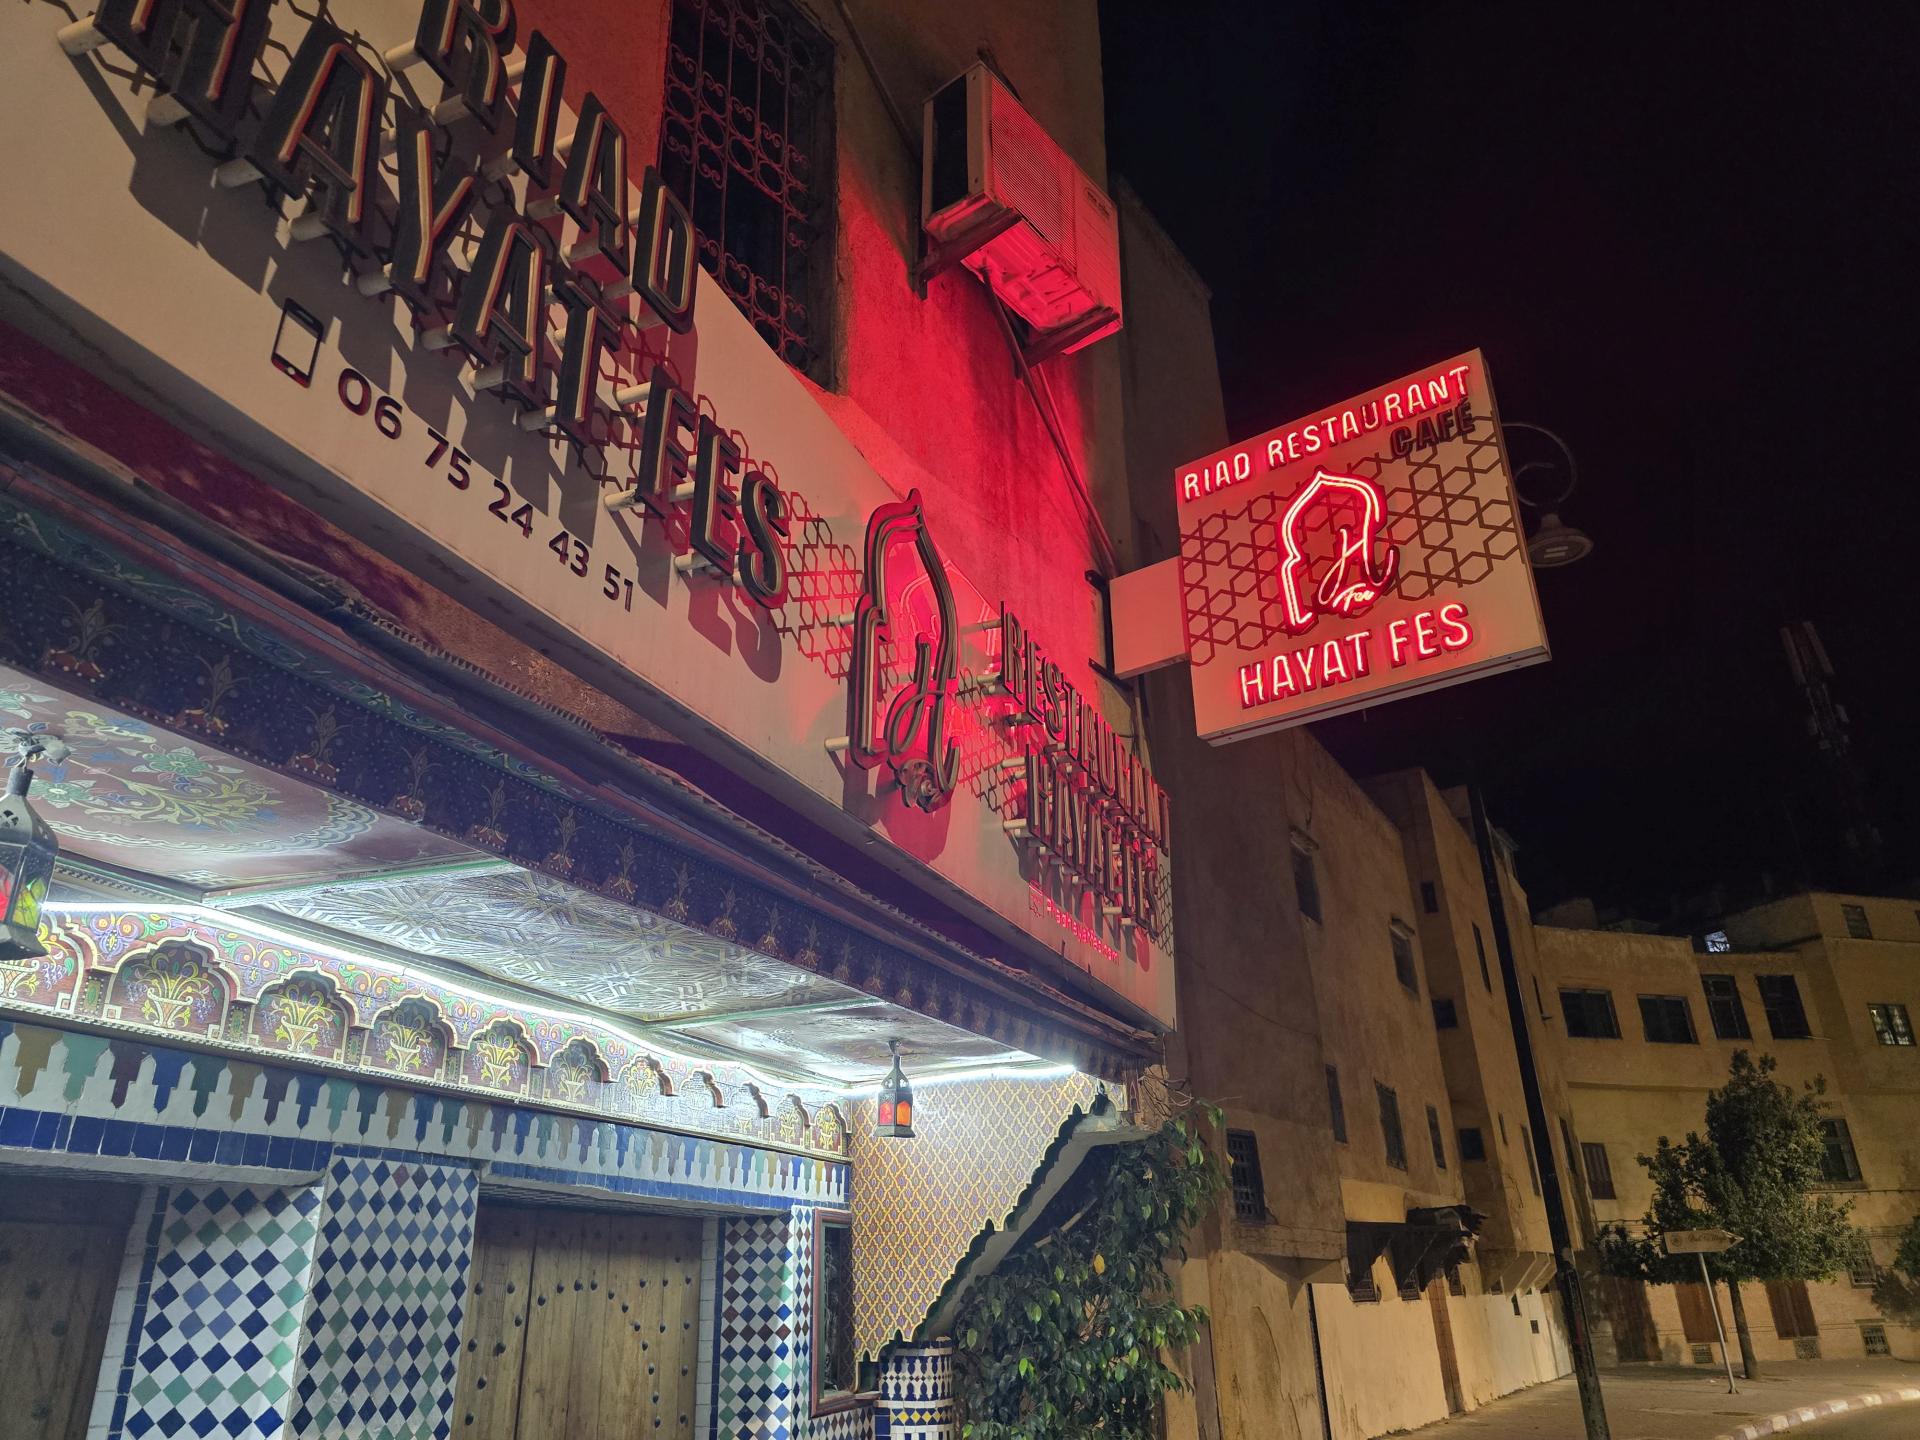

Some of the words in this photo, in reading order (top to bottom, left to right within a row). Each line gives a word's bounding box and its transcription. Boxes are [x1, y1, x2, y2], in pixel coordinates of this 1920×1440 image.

[337, 367, 404, 440] 06
[424, 427, 473, 491] 75
[488, 479, 535, 539] 24
[548, 530, 590, 578] 43
[602, 563, 635, 613] 51
[633, 366, 791, 610] FES
[1182, 449, 1253, 503] RIAD
[1266, 363, 1471, 471] RESTAURANT
[1000, 600, 1170, 857] RESTAURANT
[1238, 629, 1372, 709] HAYAT
[1387, 601, 1474, 670] FES
